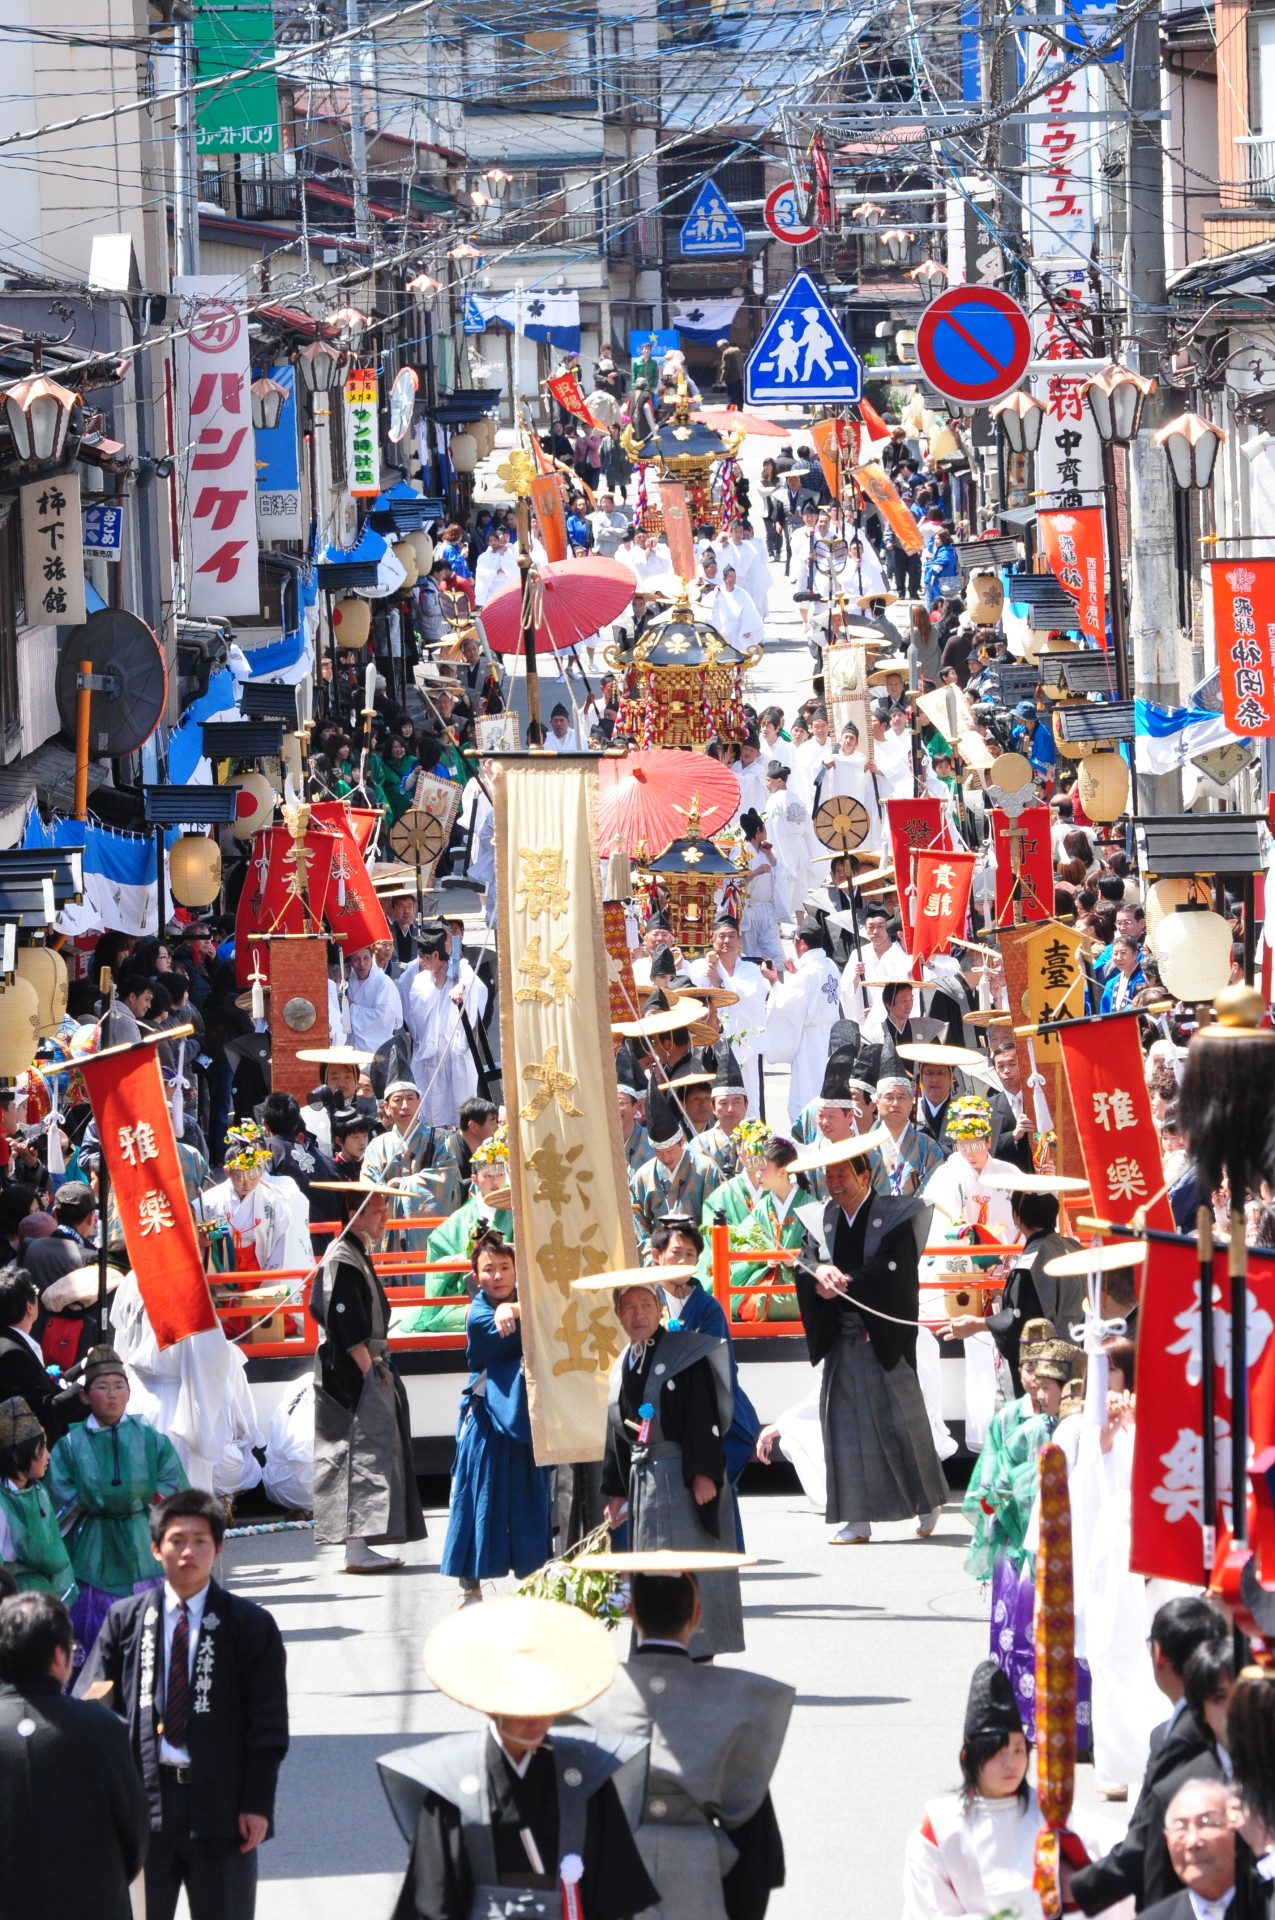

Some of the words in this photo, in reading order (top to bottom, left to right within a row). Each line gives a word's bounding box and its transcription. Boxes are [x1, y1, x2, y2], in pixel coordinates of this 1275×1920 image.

[190, 372, 248, 583] バンケイ
[352, 408, 374, 485] サン時計店
[36, 486, 67, 613] 柿下旅館
[101, 510, 117, 545] おこめ
[193, 1634, 215, 1714] 大津神社
